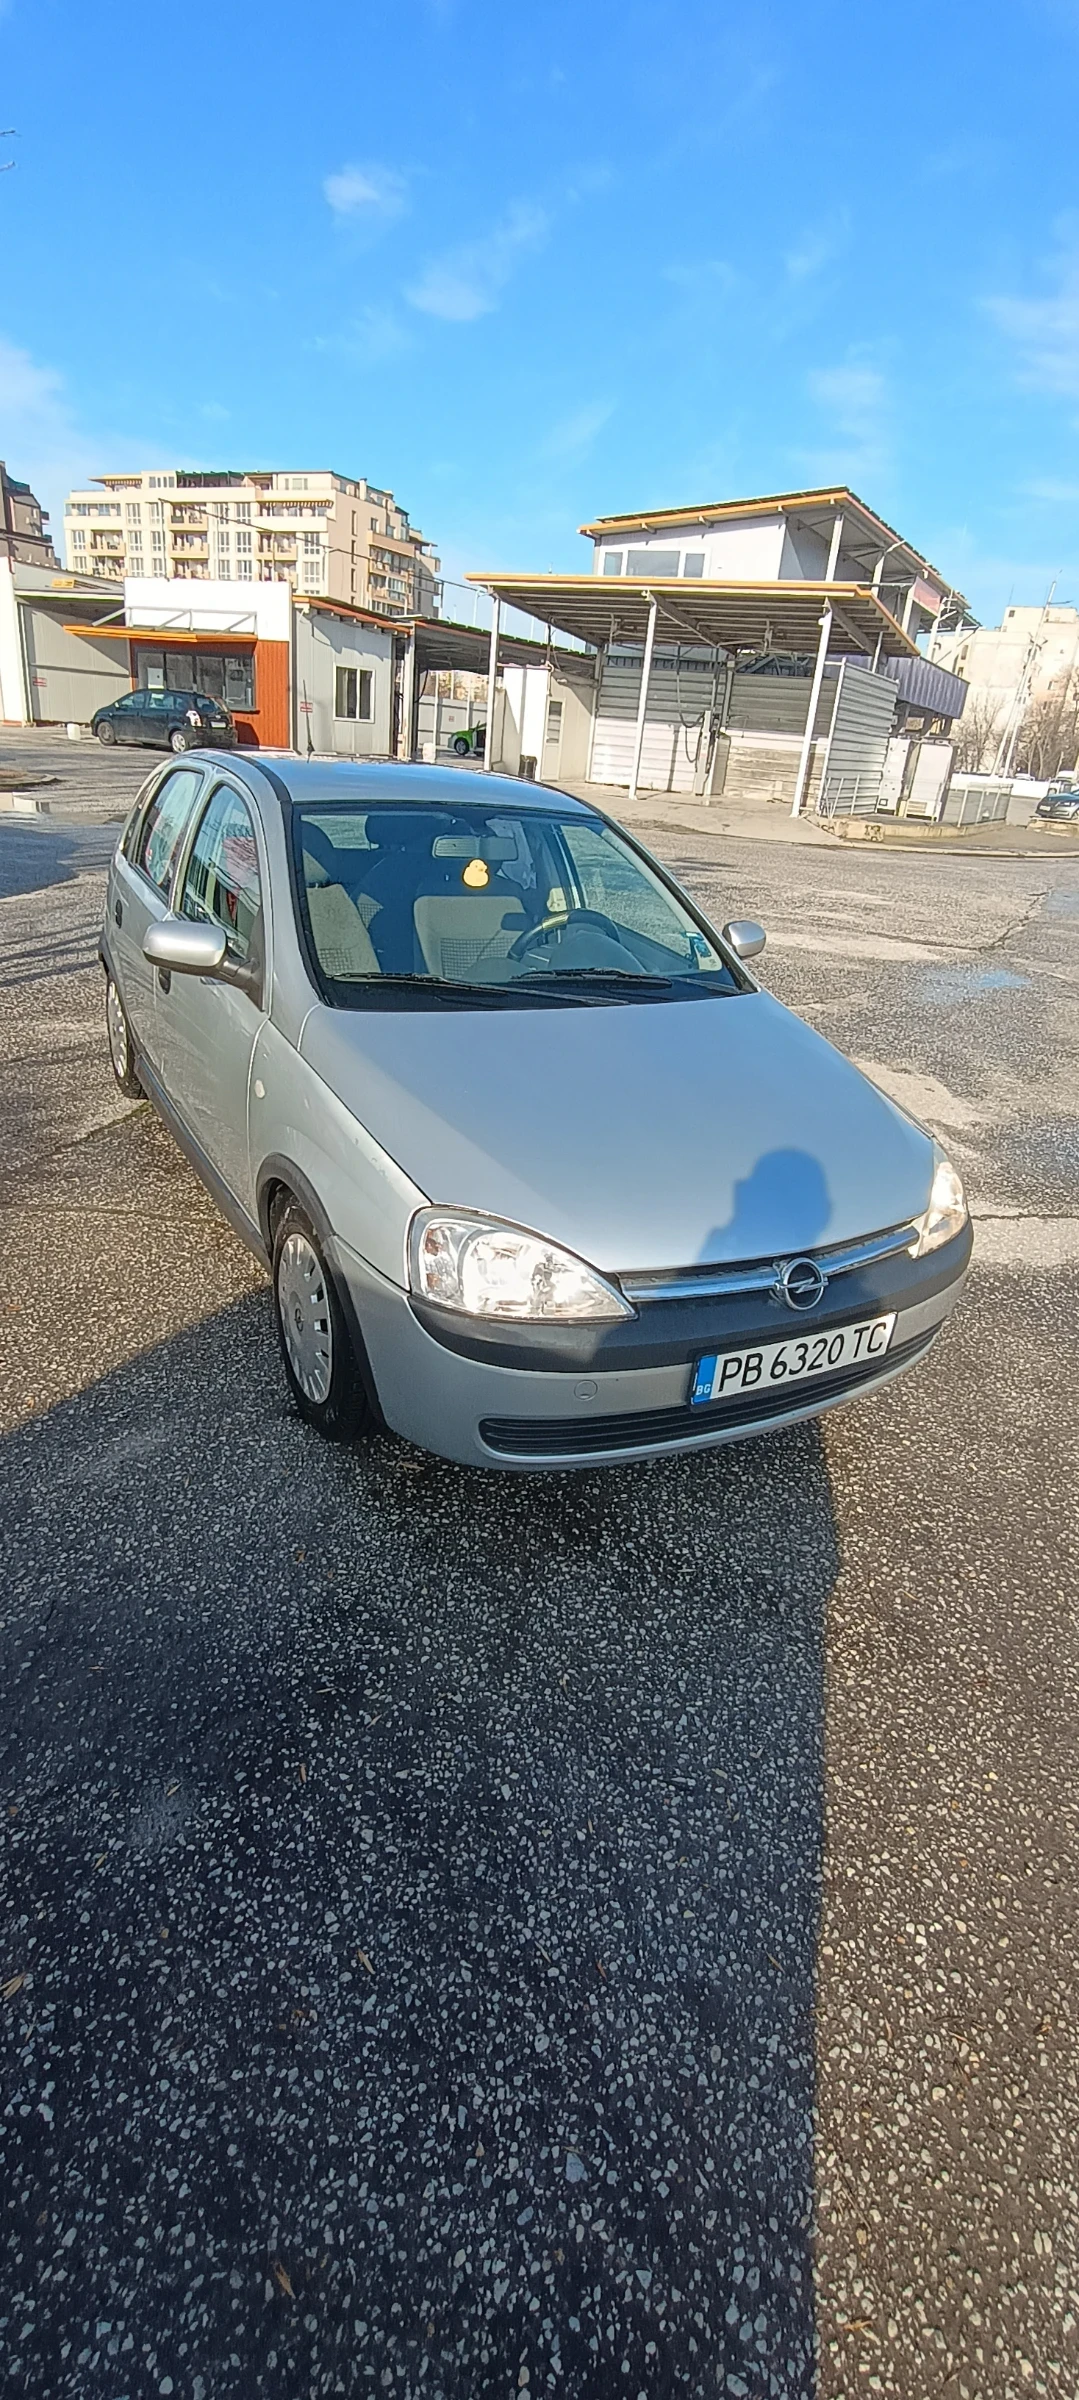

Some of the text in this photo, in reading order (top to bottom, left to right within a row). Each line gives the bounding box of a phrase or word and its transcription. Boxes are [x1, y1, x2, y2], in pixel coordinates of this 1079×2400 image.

[718, 1322, 887, 1392] PB 6320 TC
[695, 1383, 711, 1396] BG
